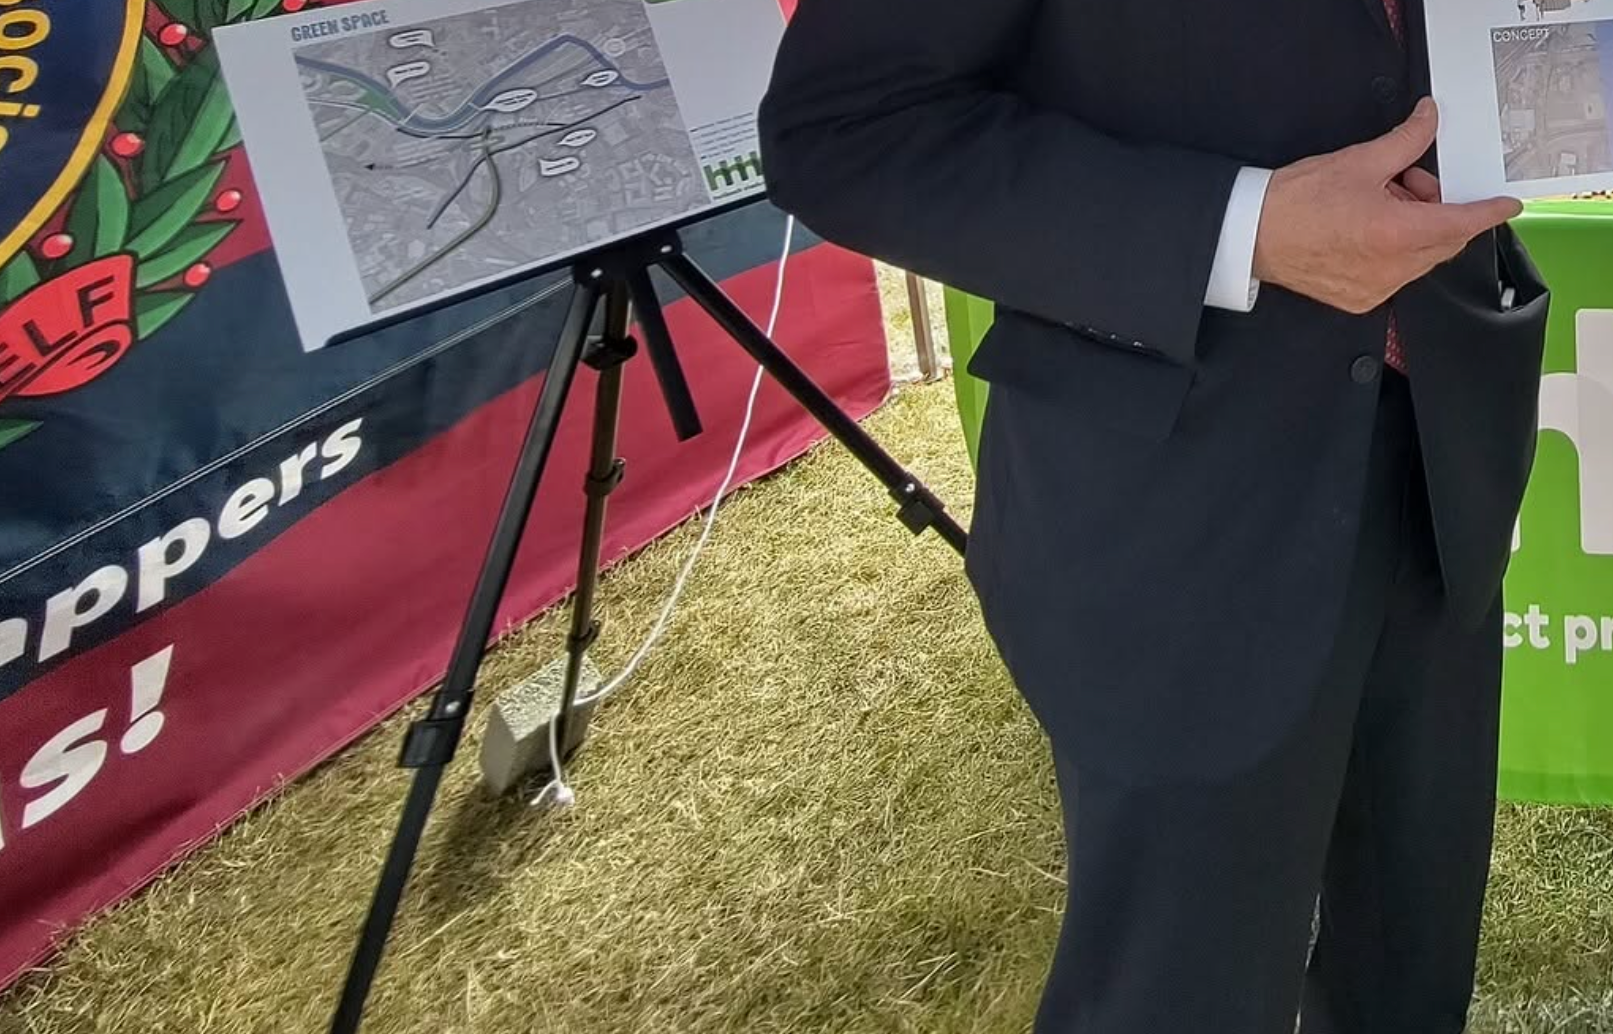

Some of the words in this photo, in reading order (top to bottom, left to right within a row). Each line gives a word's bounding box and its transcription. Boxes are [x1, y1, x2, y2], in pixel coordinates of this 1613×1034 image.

[291, 19, 340, 42] GREEN
[341, 9, 390, 32] SPACE
[1493, 28, 1549, 43] CONCEPT
